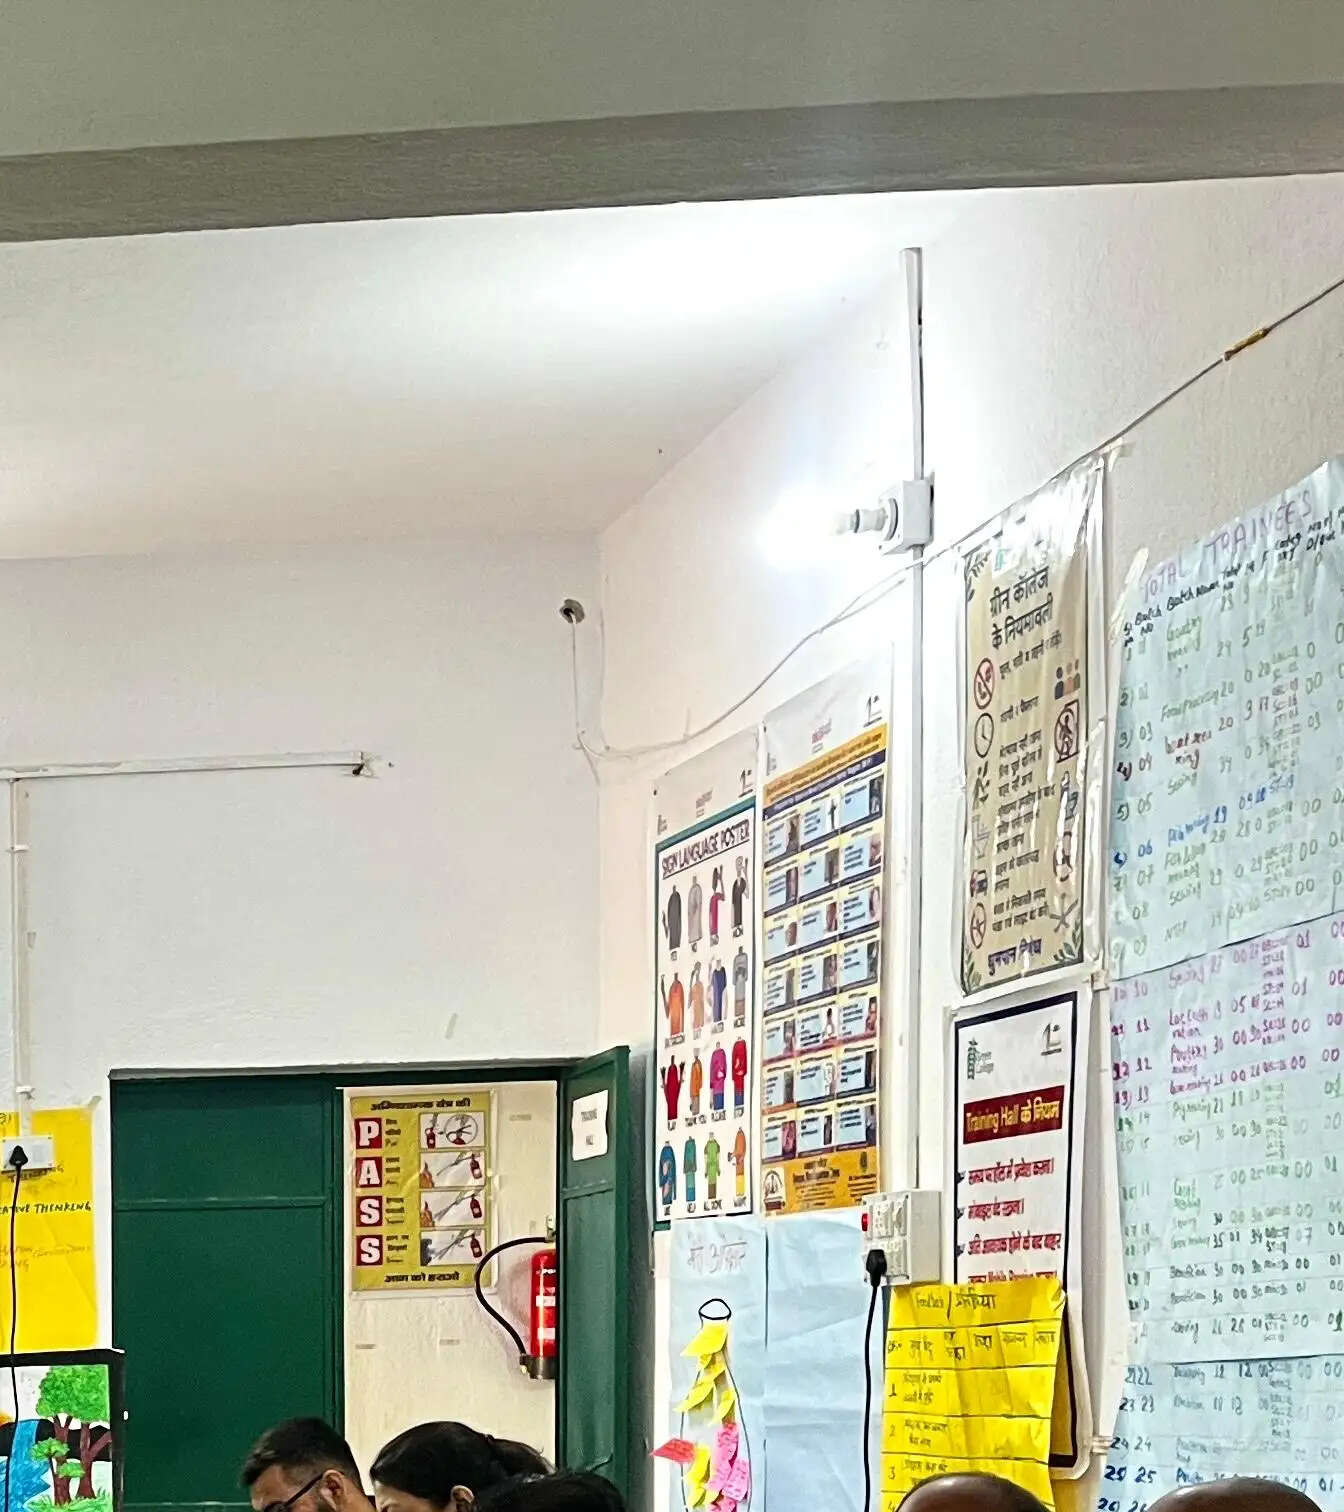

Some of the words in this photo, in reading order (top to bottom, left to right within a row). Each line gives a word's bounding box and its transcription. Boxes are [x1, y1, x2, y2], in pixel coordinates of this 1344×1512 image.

[989, 586, 1011, 617] ग्रीन
[1013, 565, 1049, 603] कॉलेज
[991, 623, 1002, 650] के
[1004, 592, 1054, 645] नियमावली
[678, 831, 719, 868] LANGUAGE
[966, 1107, 1000, 1133] Training
[1000, 1103, 1020, 1127] Hall
[1033, 1096, 1061, 1122] नियम
[359, 1120, 380, 1147] P
[359, 1159, 380, 1186] A
[359, 1198, 380, 1225] S
[360, 1237, 381, 1264] S
